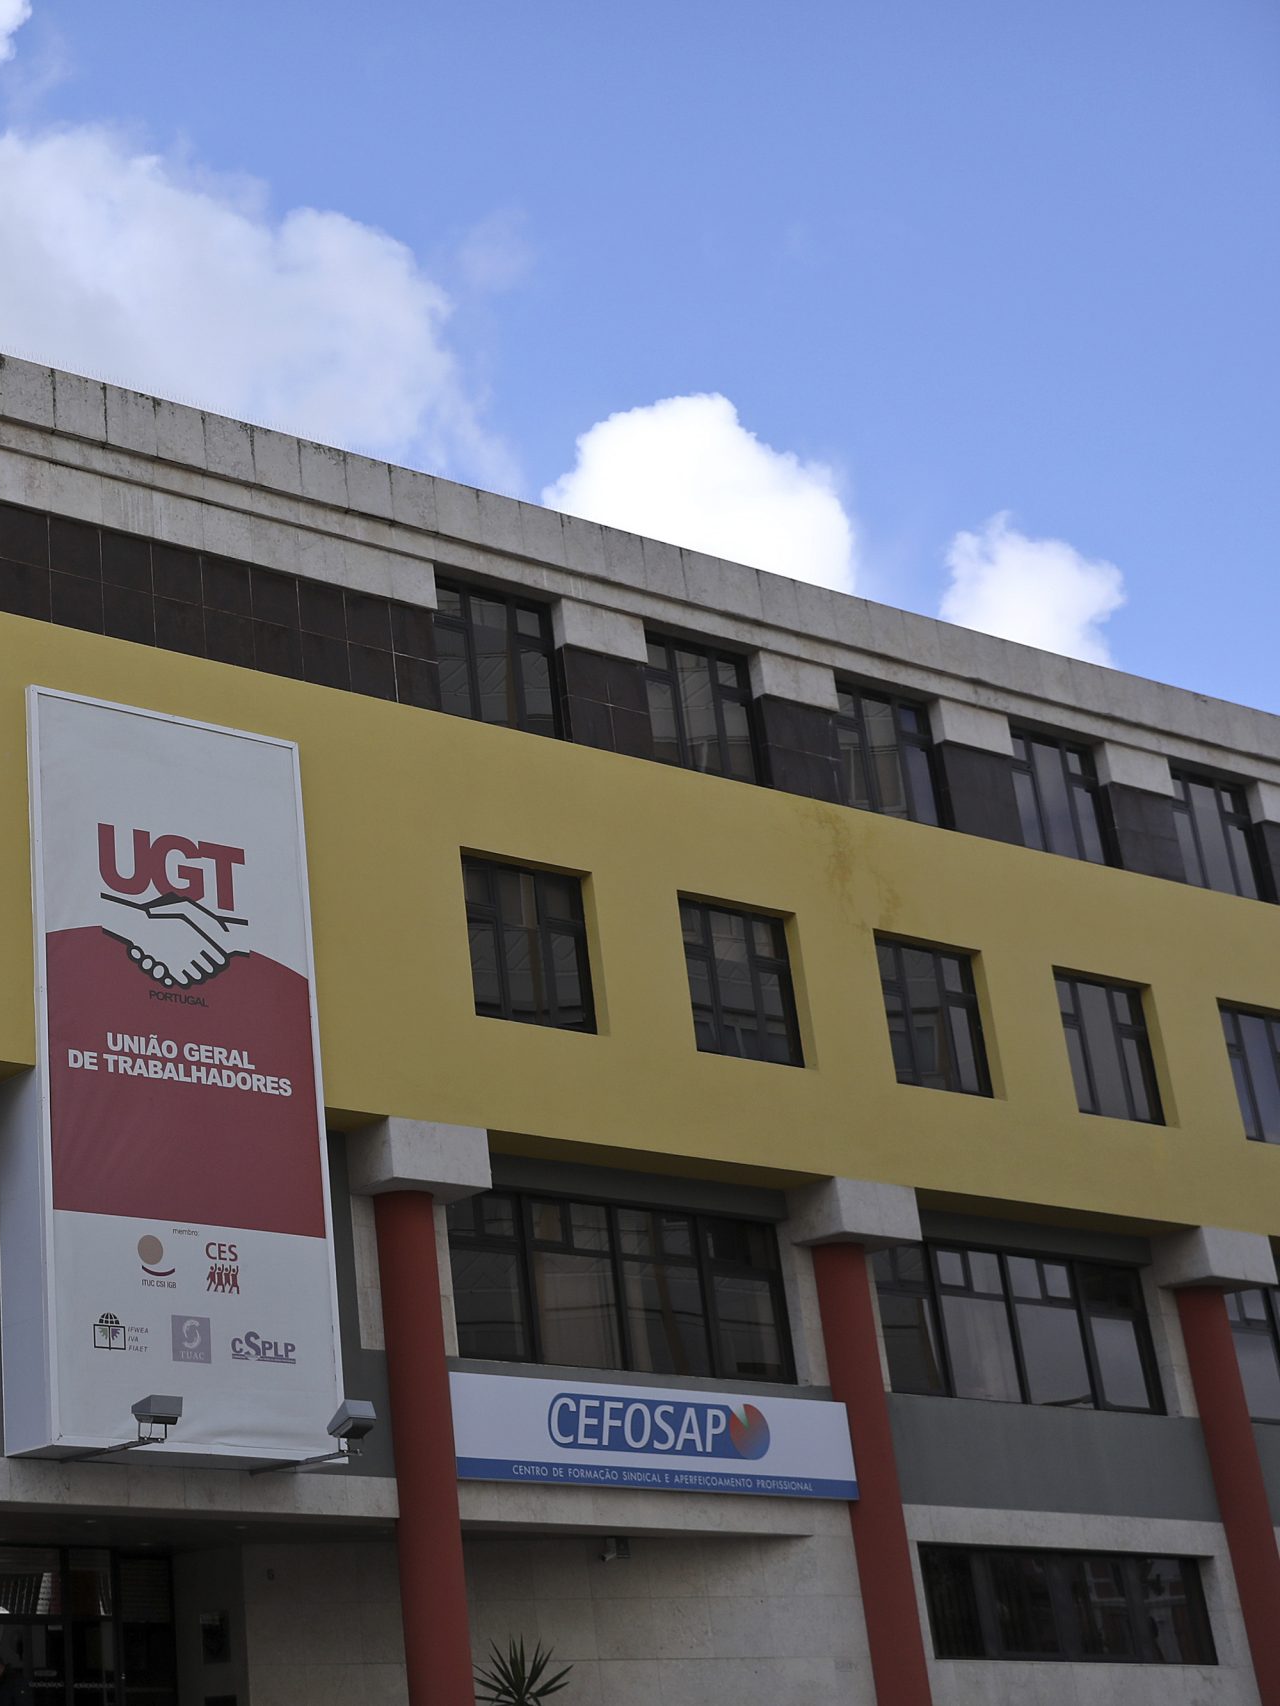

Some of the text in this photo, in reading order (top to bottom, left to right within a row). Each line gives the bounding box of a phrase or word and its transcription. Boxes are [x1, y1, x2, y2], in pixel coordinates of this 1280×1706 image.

[98, 823, 245, 911] UGT
[149, 990, 209, 1007] PORTUGAL
[106, 1032, 255, 1070] UNIÃO GERAL
[68, 1049, 292, 1097] DE TRABALHADORES
[205, 1242, 239, 1262] CES
[180, 1350, 205, 1360] TUAC
[550, 1397, 726, 1453] CEFOSAP
[512, 1464, 813, 1492] CENTRO DE FORMAÇÃO SINDICAL E APERFEIÇOAMENTO PROFISSIONAL
